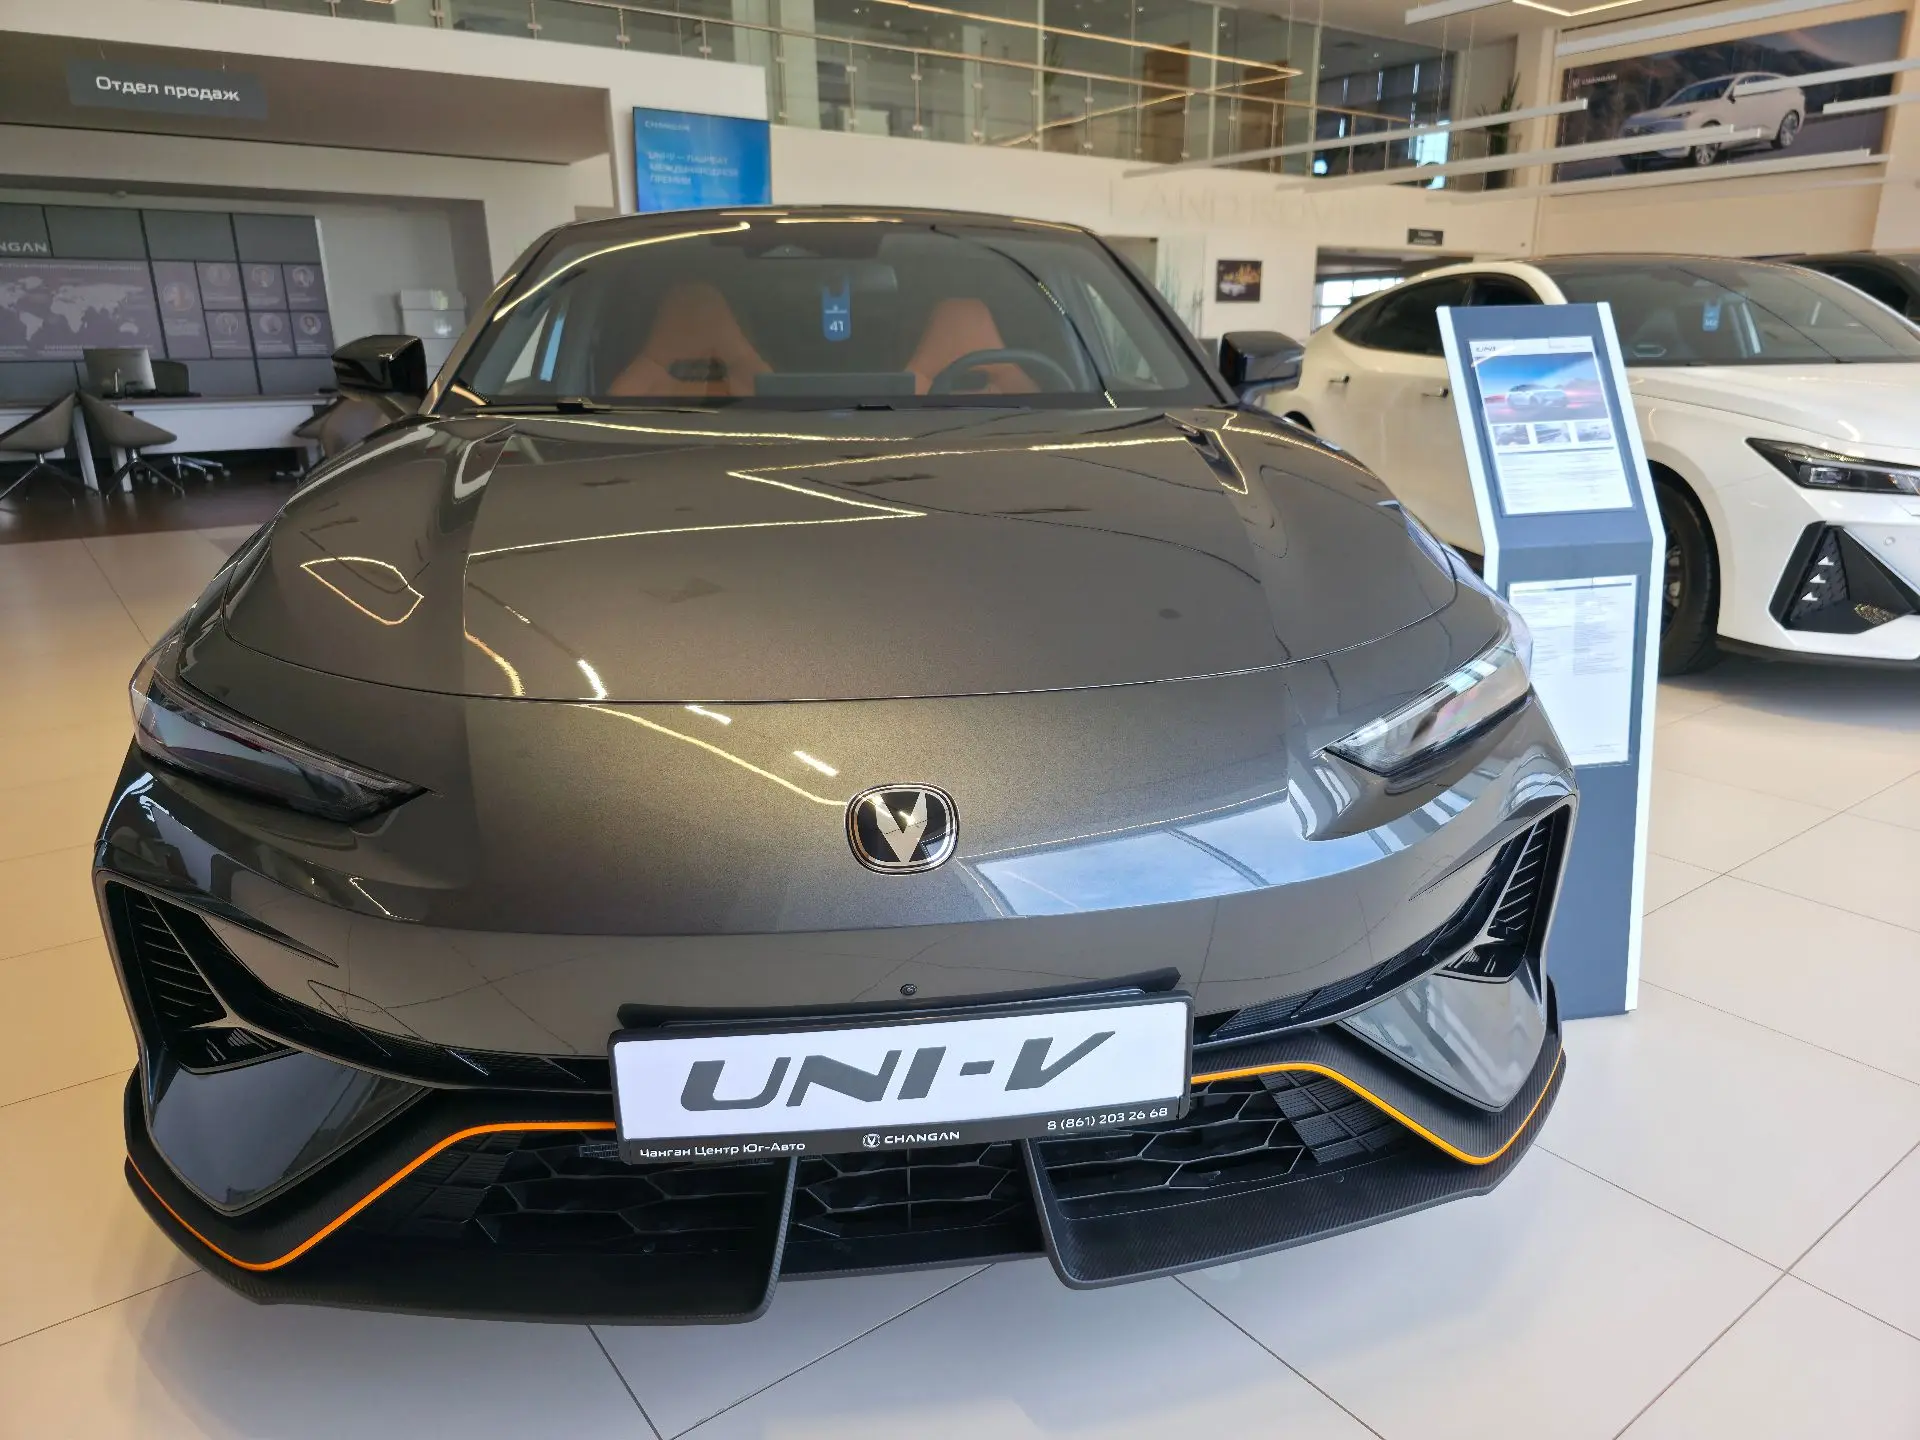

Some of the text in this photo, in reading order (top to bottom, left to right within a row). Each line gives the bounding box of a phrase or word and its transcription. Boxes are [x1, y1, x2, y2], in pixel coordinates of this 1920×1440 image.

[96, 76, 240, 102] Отдел продаж
[830, 320, 844, 332] 41
[680, 1031, 1116, 1111] UNI-V
[1047, 1107, 1168, 1130] 8 (861) 203 26 68
[884, 1132, 960, 1144] CHANGAN
[640, 1142, 806, 1158] Чанган Центр Юг-Авто
